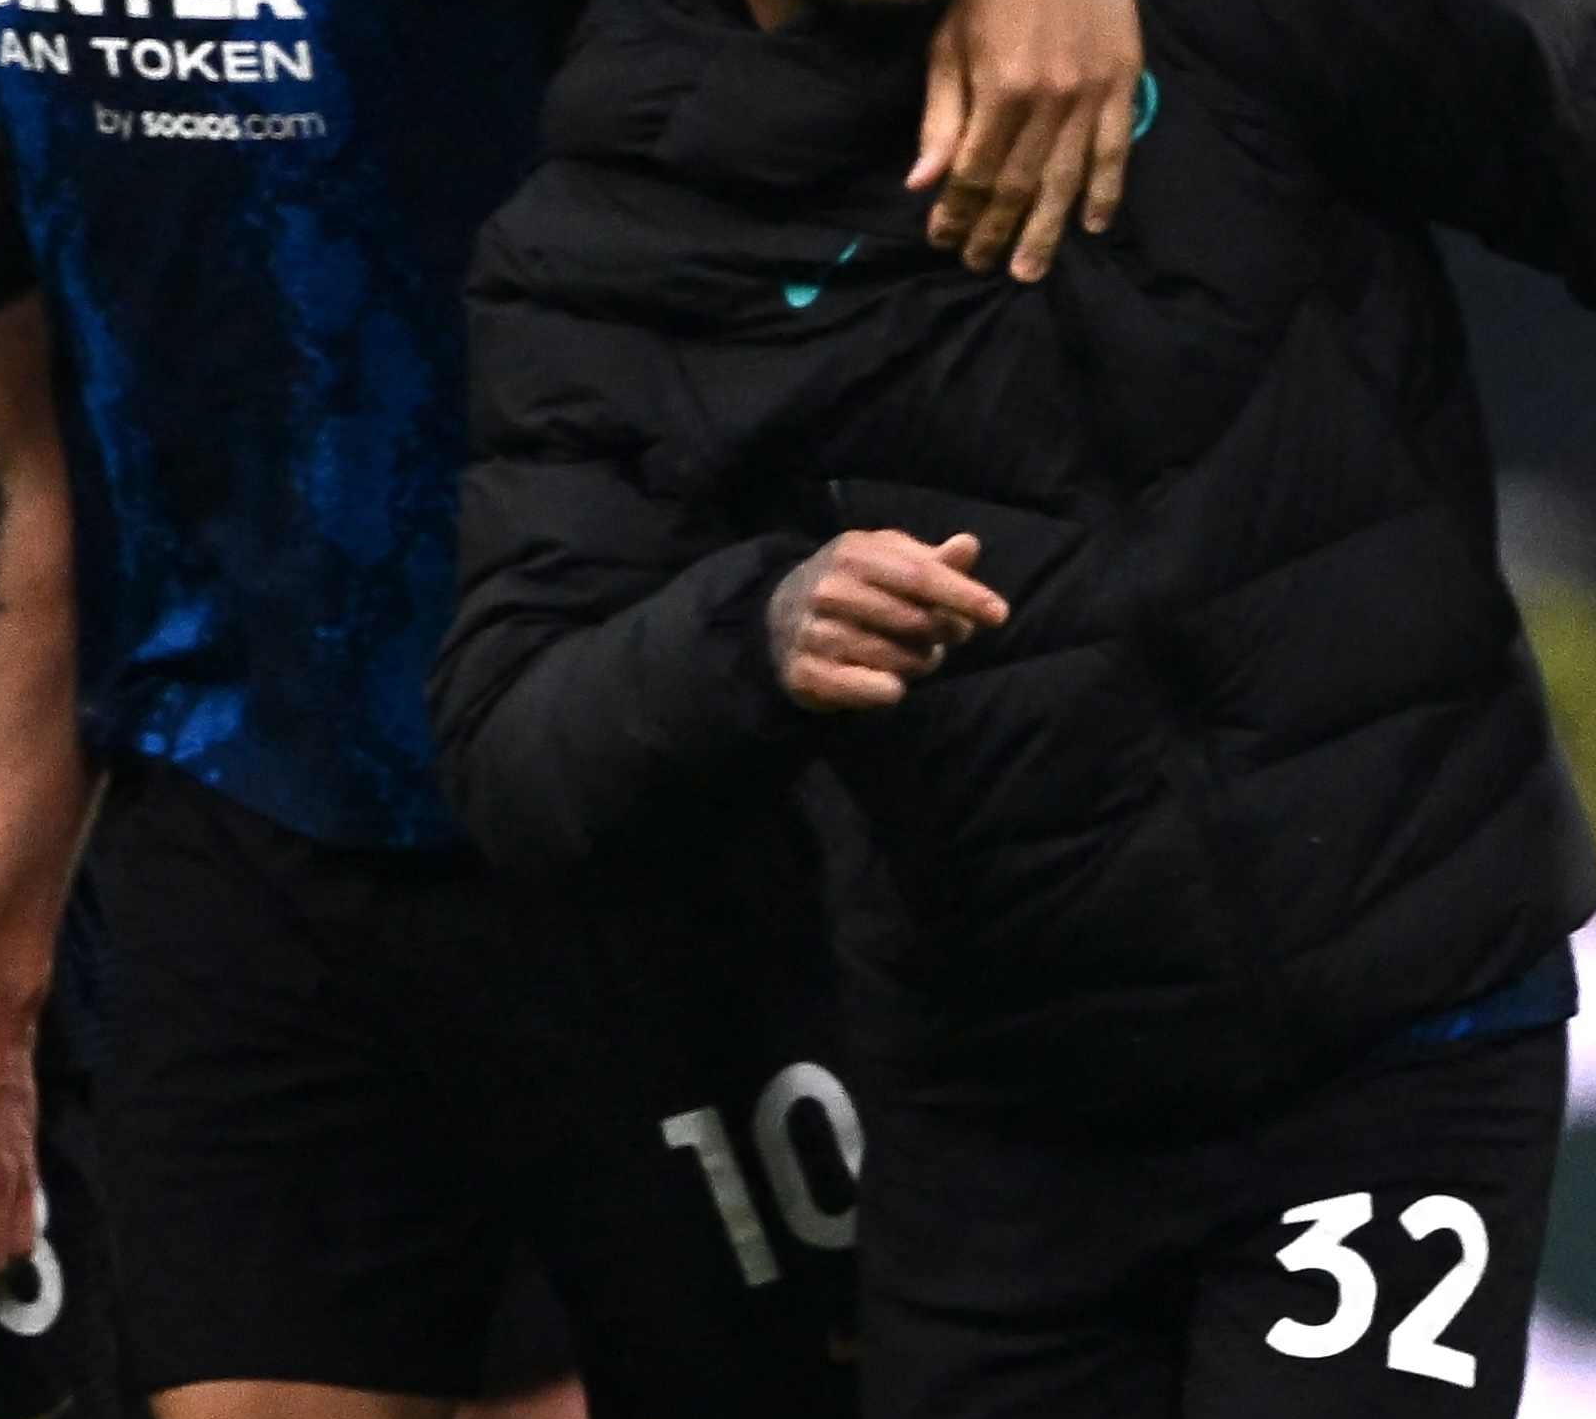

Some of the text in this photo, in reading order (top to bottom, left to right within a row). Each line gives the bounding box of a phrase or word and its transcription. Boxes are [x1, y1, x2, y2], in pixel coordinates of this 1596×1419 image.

[88, 35, 316, 83] TOKEN
[92, 97, 327, 142] by socios.com
[659, 1059, 867, 1288] 10
[1264, 1190, 1490, 1389] 32
